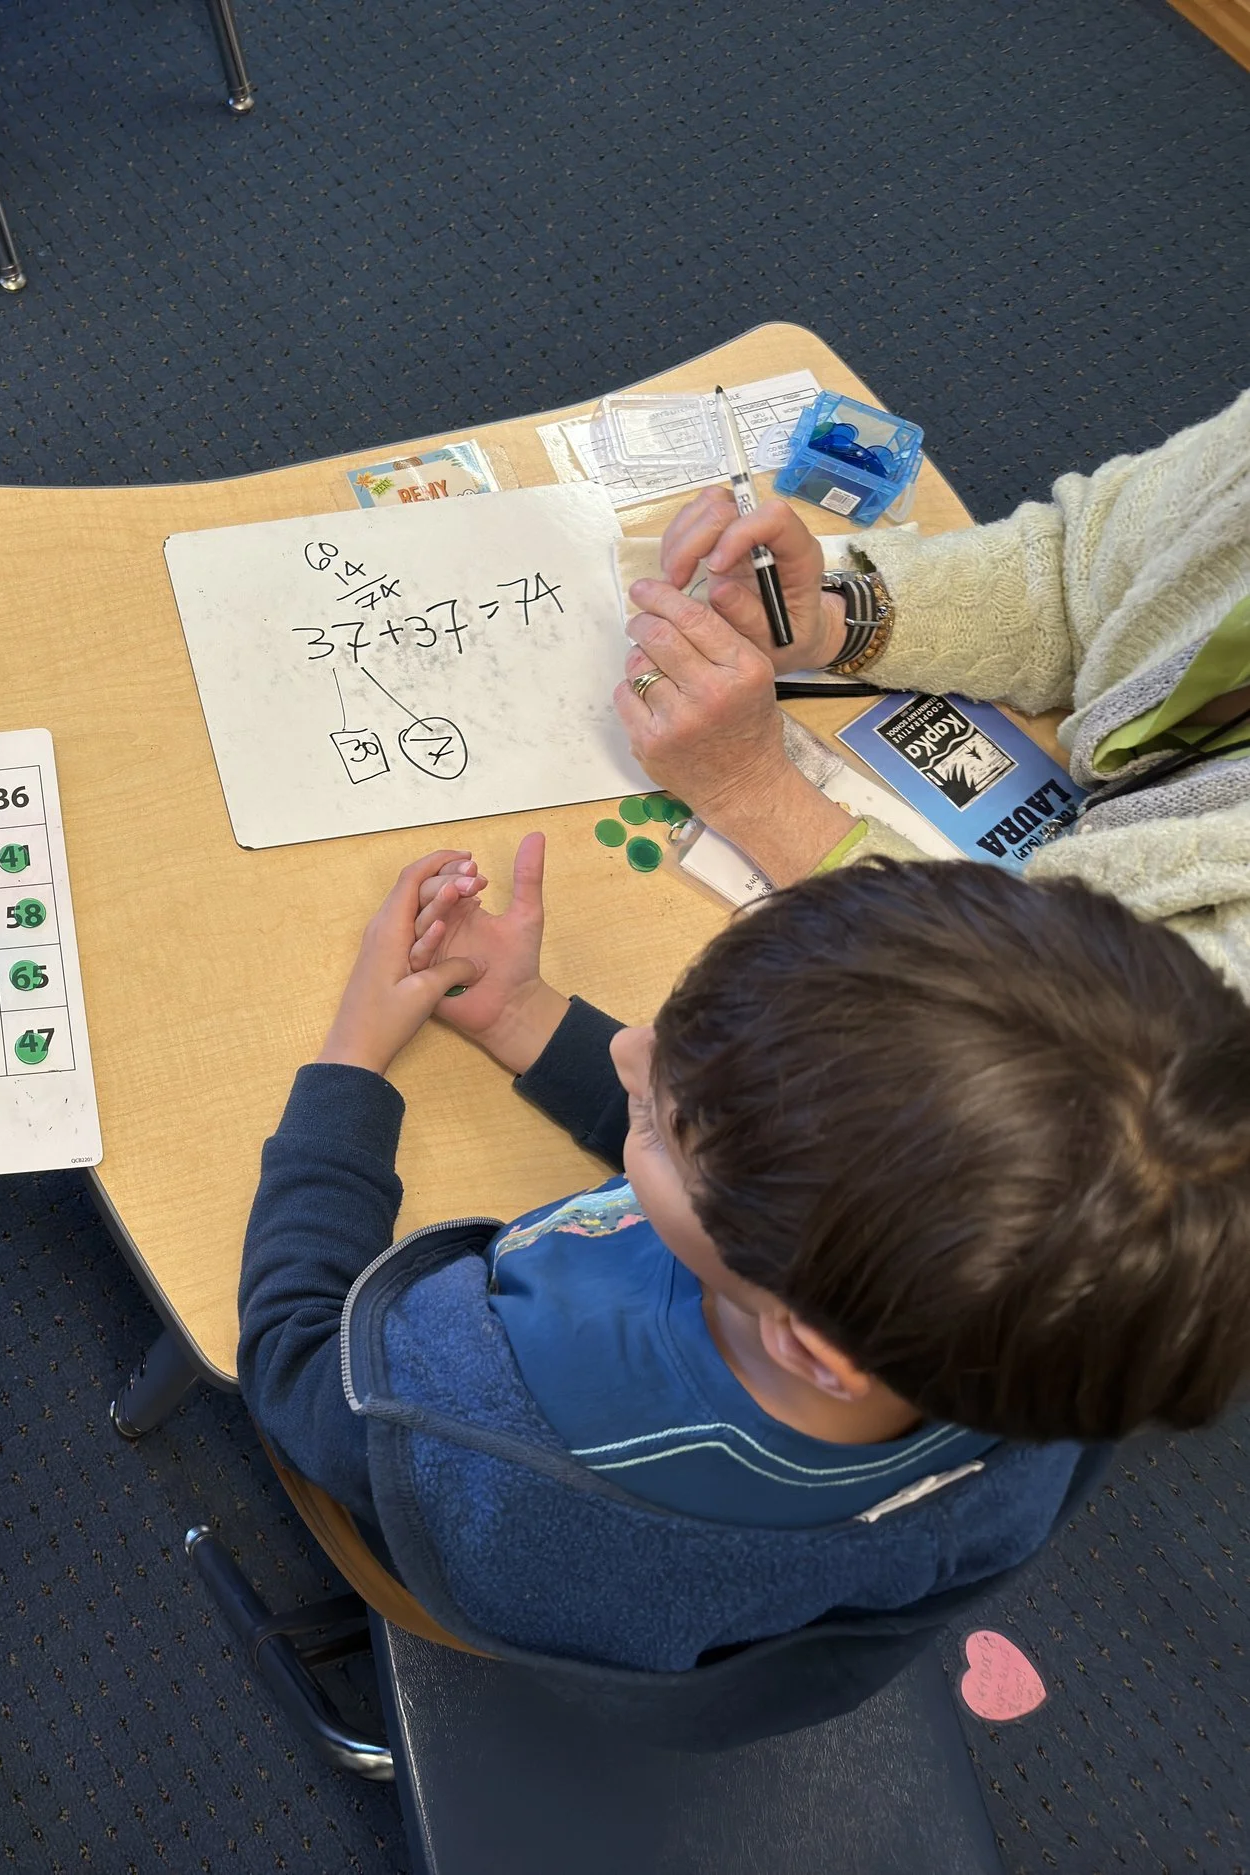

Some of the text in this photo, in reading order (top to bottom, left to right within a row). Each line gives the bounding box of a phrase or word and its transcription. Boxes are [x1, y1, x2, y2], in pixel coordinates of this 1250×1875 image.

[907, 696, 938, 723] ELEMENTARY
[886, 719, 909, 737] SCHOOL
[892, 702, 944, 743] COOPERATIVE
[976, 779, 1072, 858] LAURA
[0, 845, 30, 868] 41
[746, 874, 760, 890] 8:40
[6, 904, 42, 929] 58
[11, 966, 49, 990] 65
[18, 1029, 55, 1053] 47
